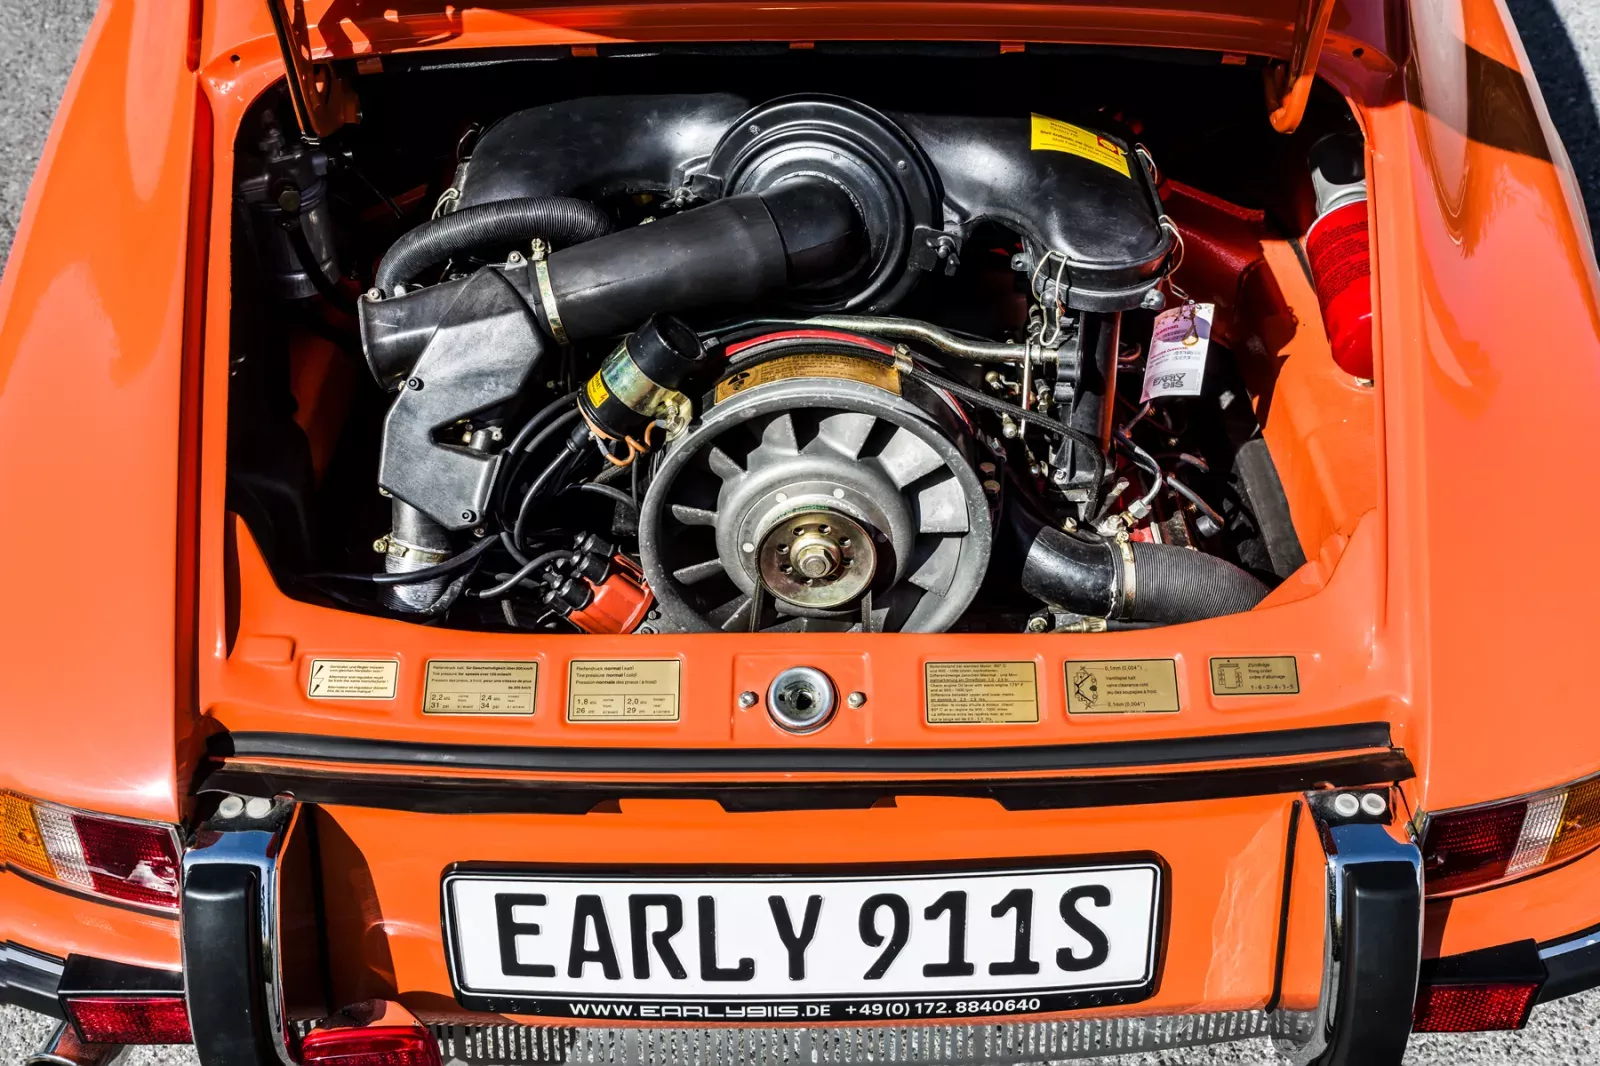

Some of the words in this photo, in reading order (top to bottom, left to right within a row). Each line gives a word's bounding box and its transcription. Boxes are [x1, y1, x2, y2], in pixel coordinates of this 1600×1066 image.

[1153, 373, 1186, 386] EARLY
[494, 893, 824, 981] EARLY
[858, 884, 1111, 980] 911S
